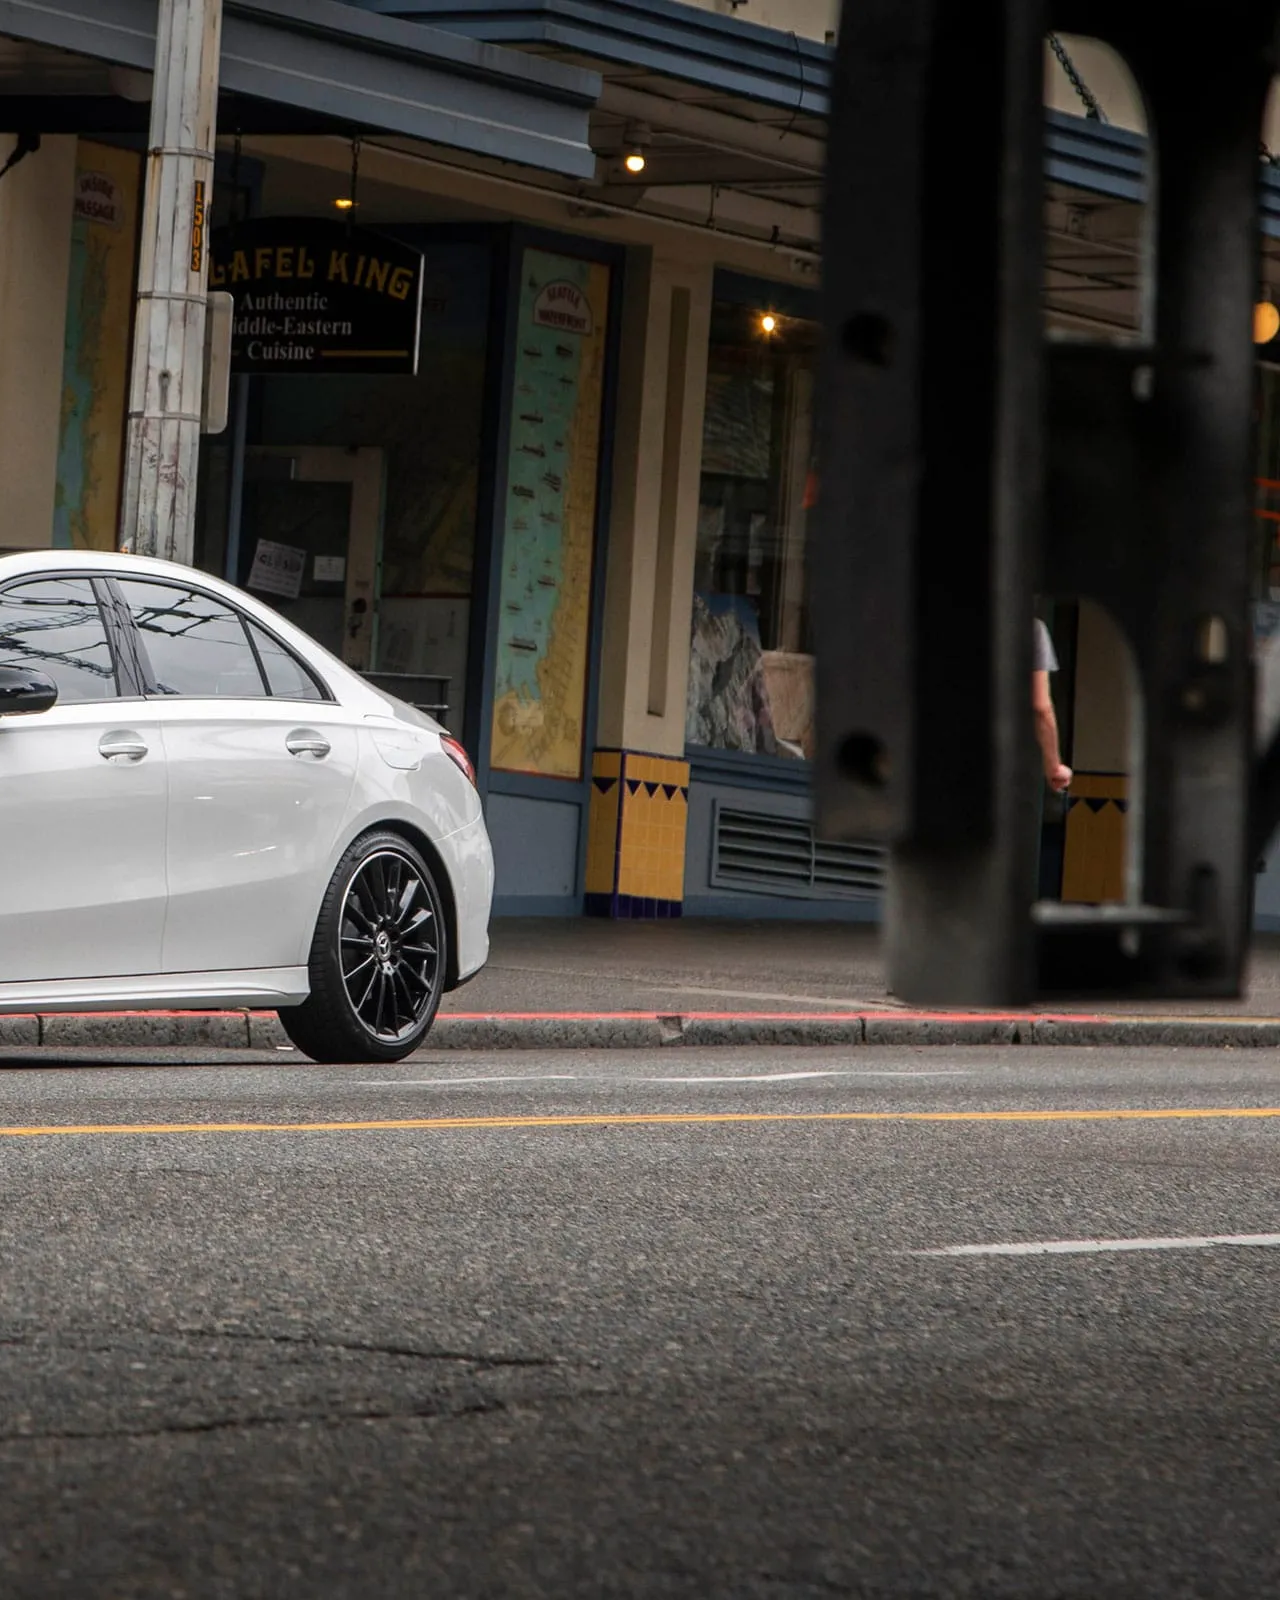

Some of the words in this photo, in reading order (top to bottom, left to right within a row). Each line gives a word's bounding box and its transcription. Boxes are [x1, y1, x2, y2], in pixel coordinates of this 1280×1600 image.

[191, 180, 205, 272] 1503
[209, 245, 315, 287] LAFEL
[325, 249, 417, 300] KING
[240, 291, 329, 311] Authentic
[232, 316, 353, 336] iddle-Eastern
[246, 340, 315, 361] Cuisine
